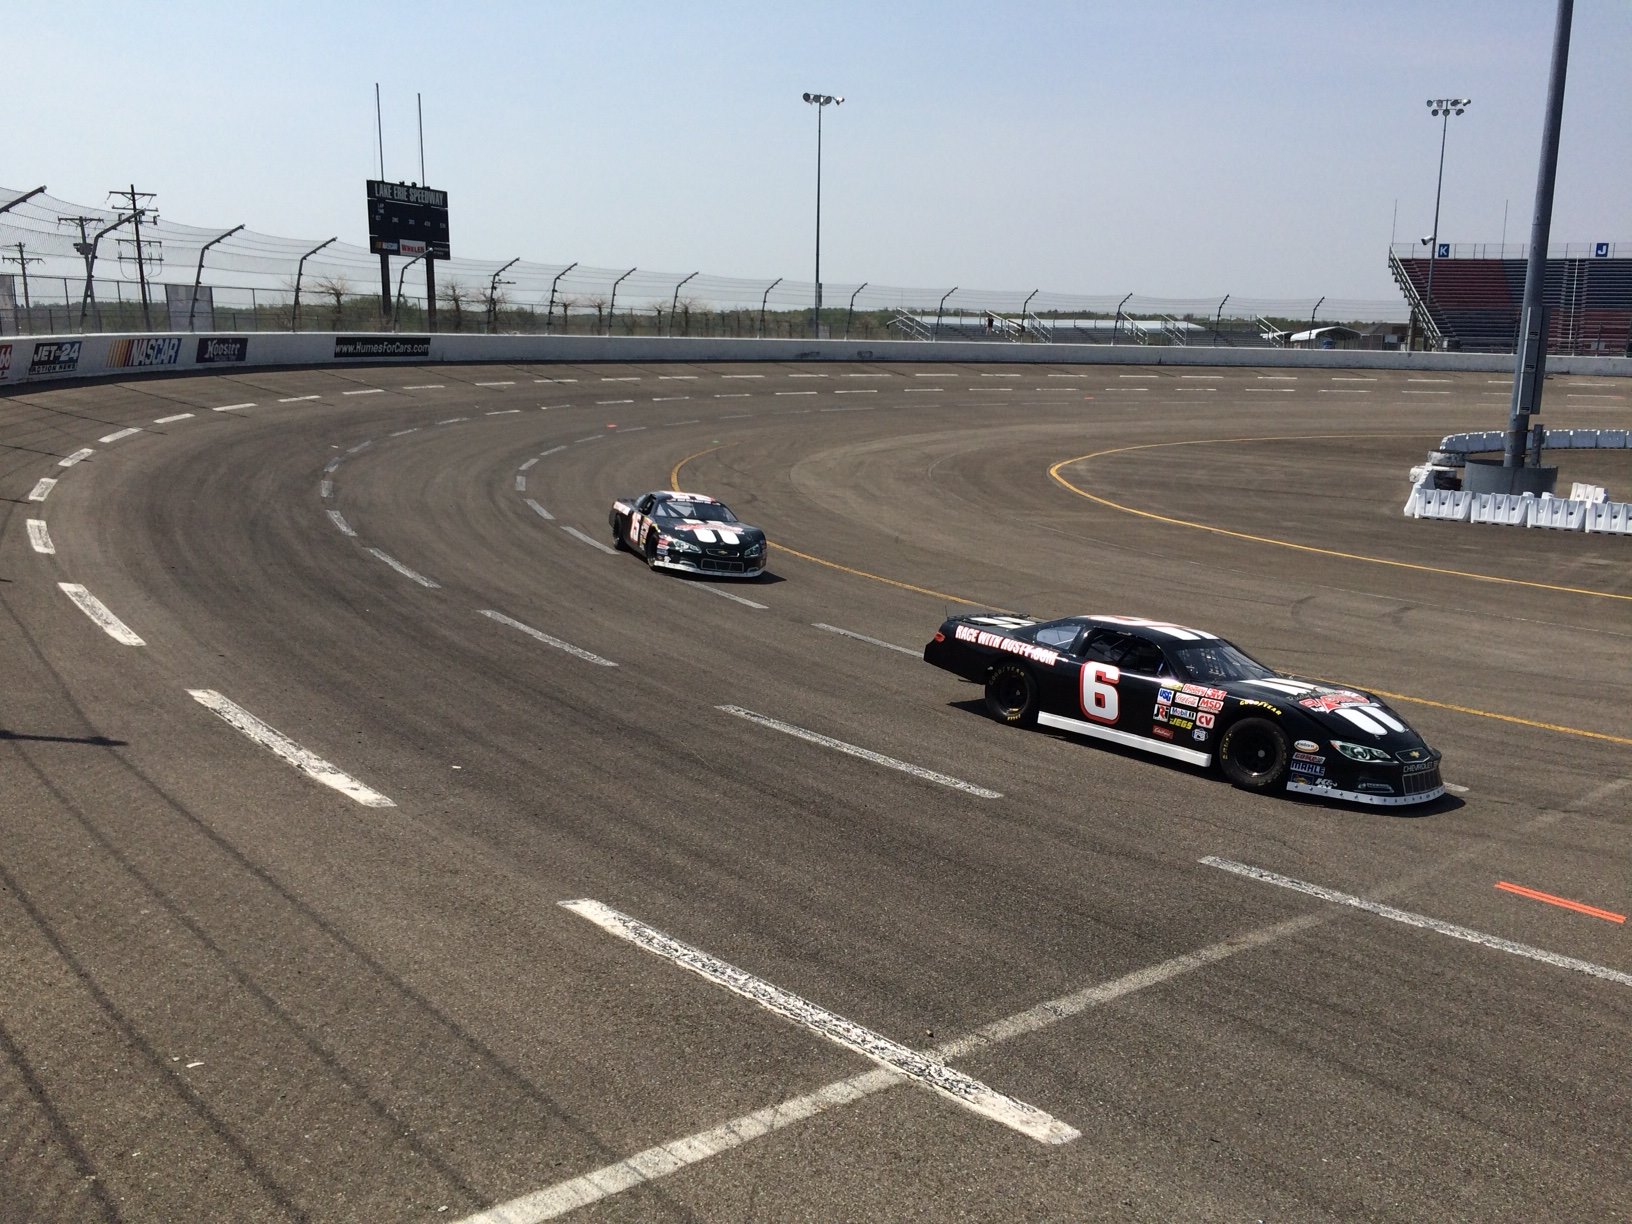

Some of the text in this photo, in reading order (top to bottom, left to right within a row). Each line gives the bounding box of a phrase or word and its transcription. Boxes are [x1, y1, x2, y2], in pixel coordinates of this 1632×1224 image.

[375, 183, 443, 206] LAKE ERIE SPEEDWAY
[1440, 246, 1448, 256] K
[1597, 245, 1607, 255] J
[129, 339, 180, 367] NASCAR
[204, 339, 241, 359] Hoosier
[336, 341, 430, 353] www.HumesForCars.com
[955, 624, 980, 643] RACE
[977, 630, 1004, 649] WITH
[1080, 659, 1120, 725] 6
[1200, 699, 1222, 710] MSD
[1239, 699, 1282, 716] GOODYEAR
[1171, 707, 1188, 716] Mobil
[1170, 718, 1193, 729] JEGS
[1198, 715, 1212, 726] CV
[1291, 761, 1325, 776] MAHLE
